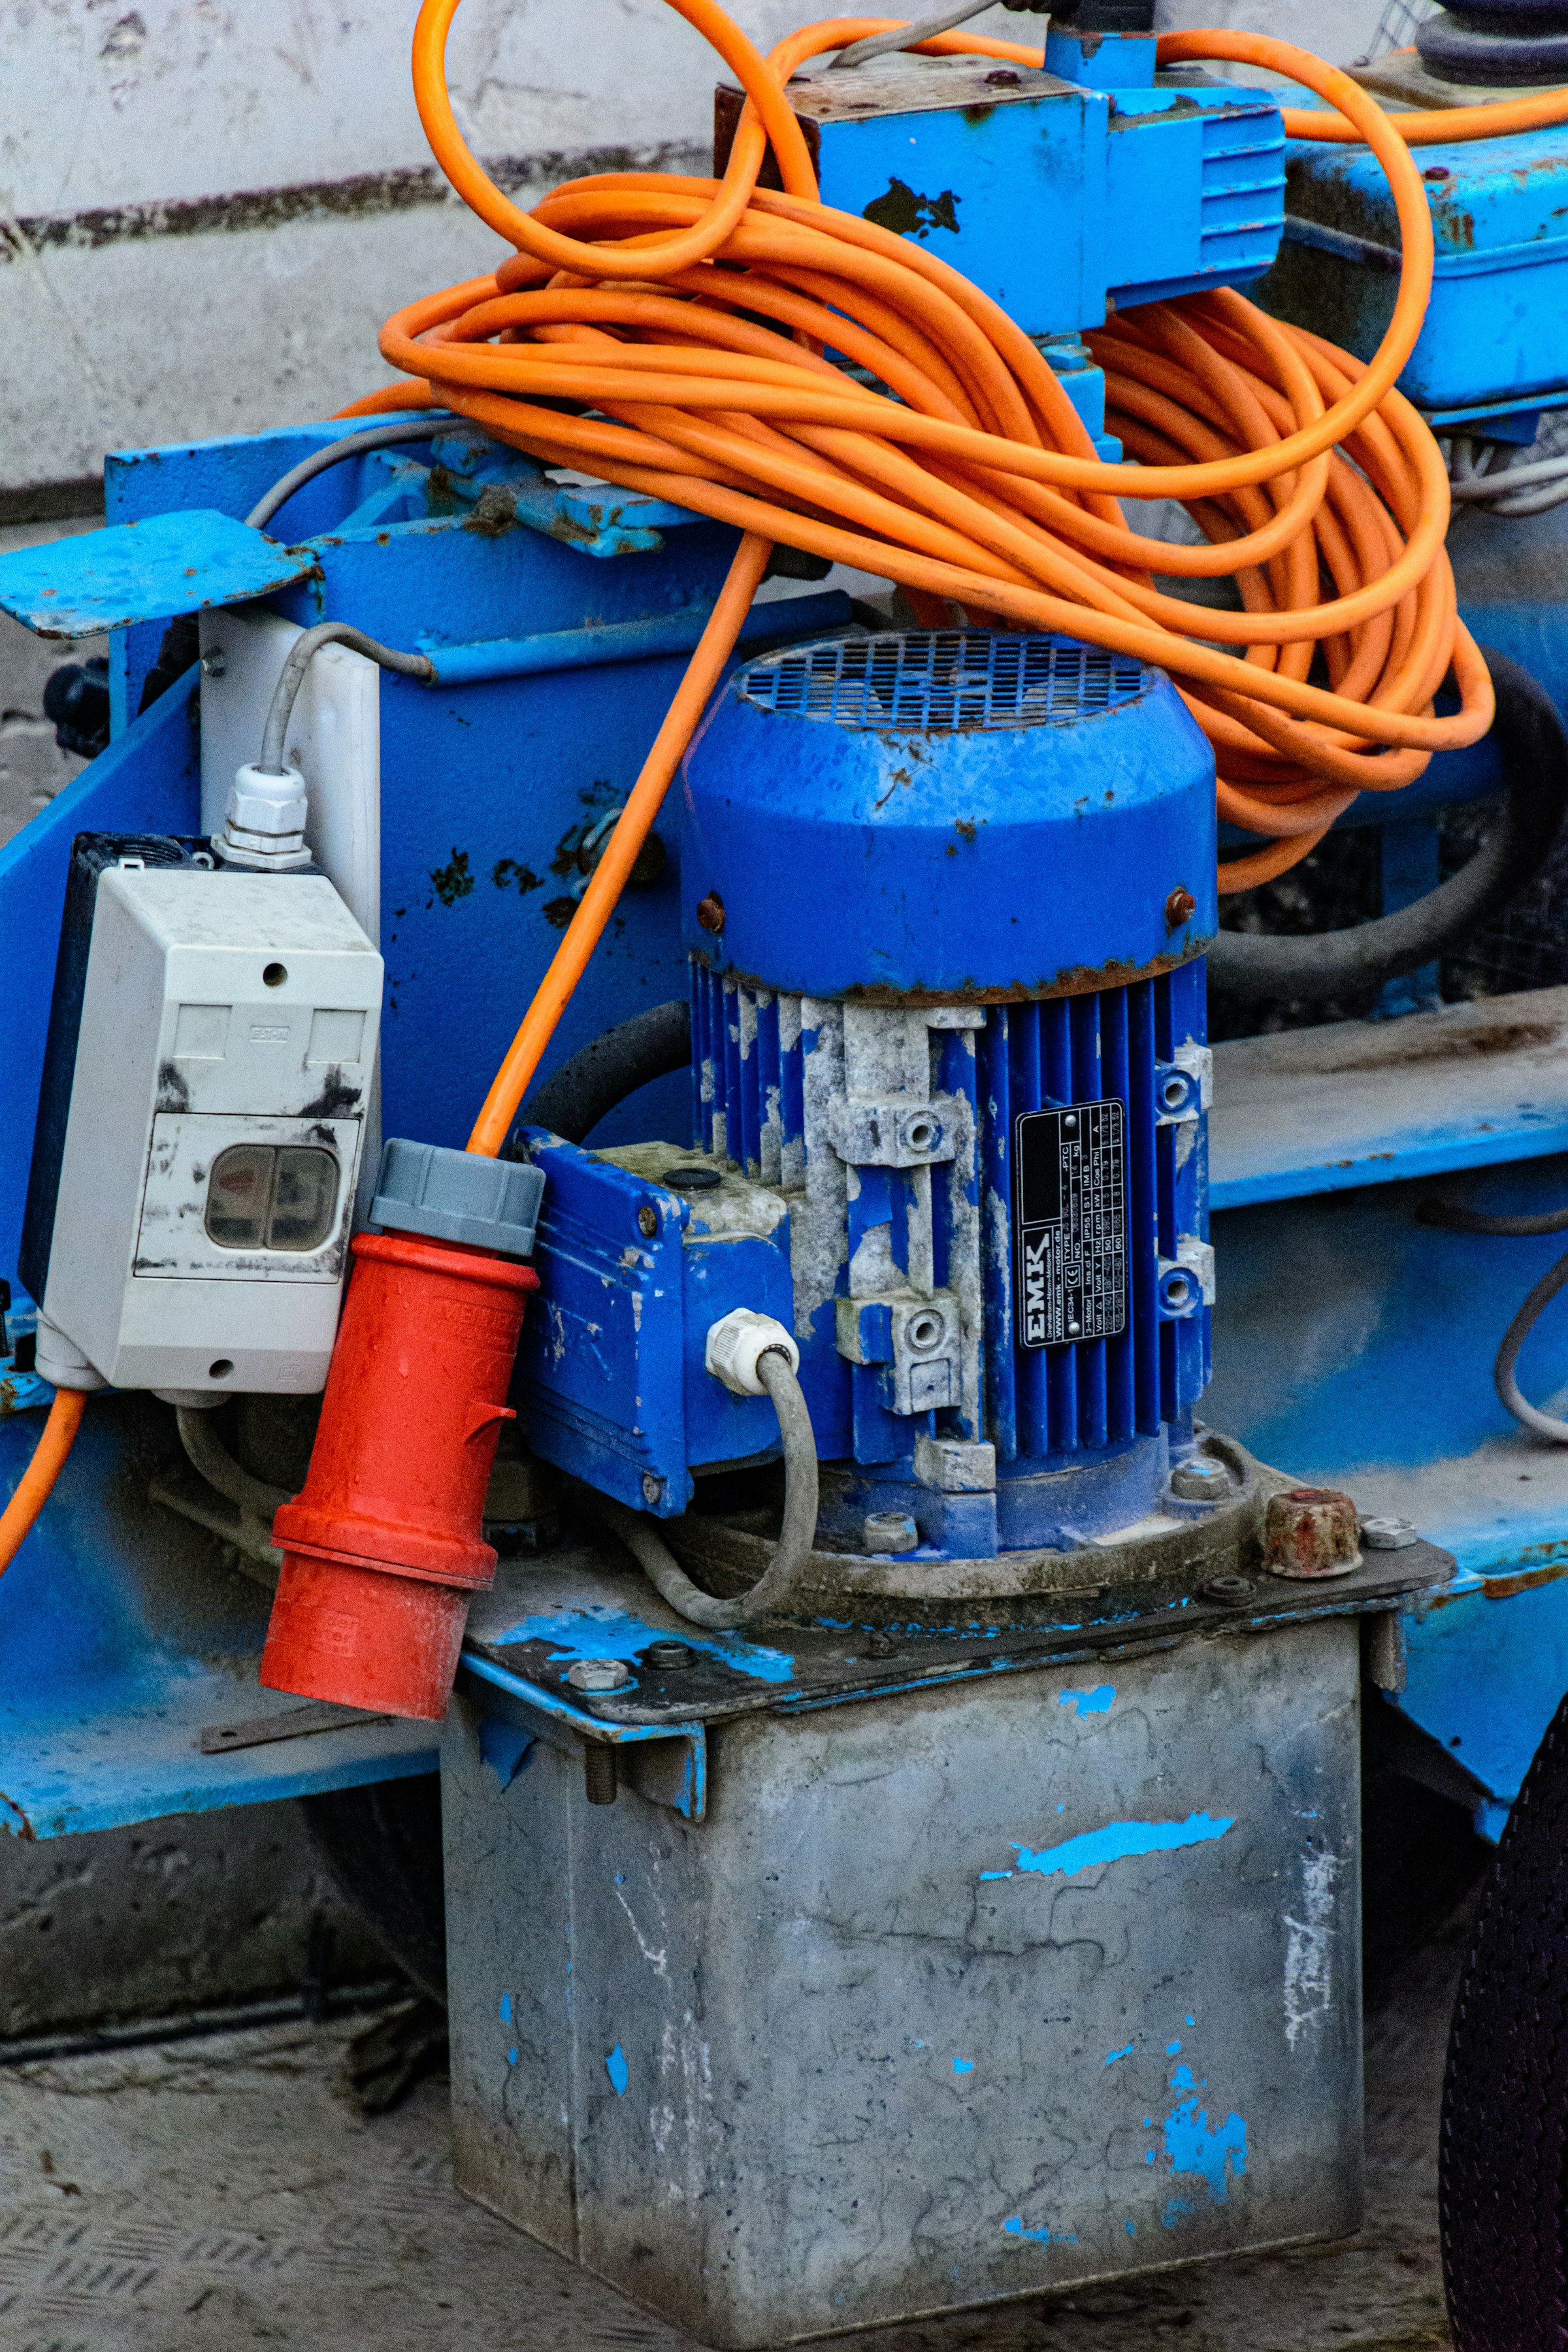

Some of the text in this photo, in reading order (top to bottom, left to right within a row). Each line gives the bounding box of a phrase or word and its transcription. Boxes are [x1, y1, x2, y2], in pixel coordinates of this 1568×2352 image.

[1073, 1144, 1080, 1157] kg
[1083, 1175, 1089, 1186] IM
[1083, 1196, 1090, 1208] S1
[1094, 1194, 1100, 1207] kW
[1094, 1240, 1101, 1252] Hz
[1105, 1239, 1111, 1250] 50
[1115, 1237, 1121, 1249] 60
[1026, 1233, 1051, 1341] EMK
